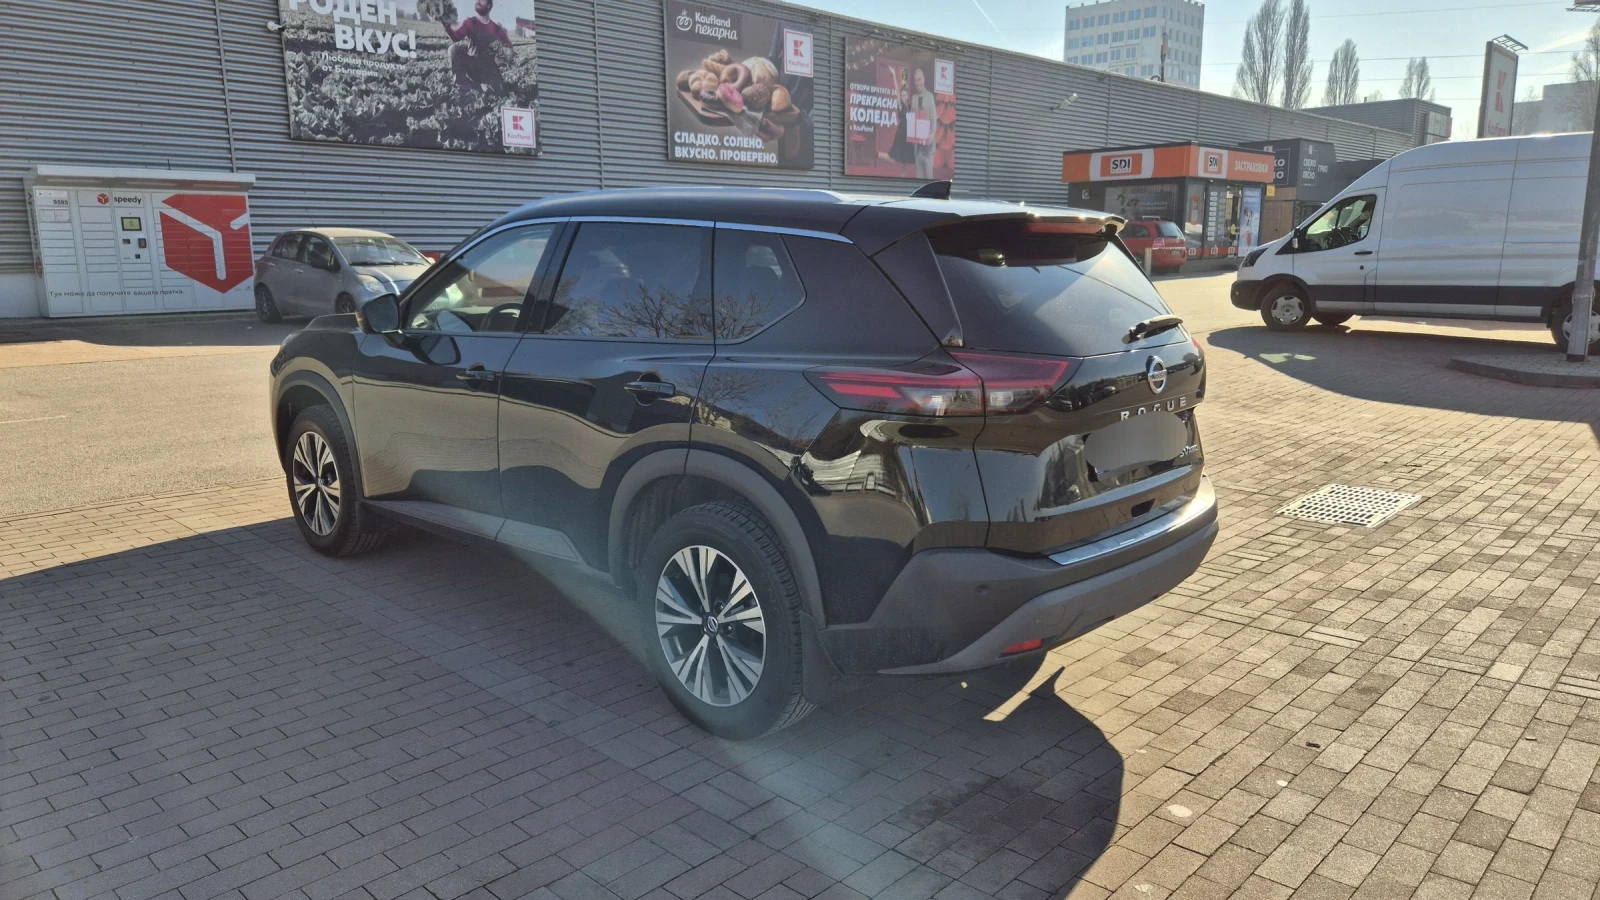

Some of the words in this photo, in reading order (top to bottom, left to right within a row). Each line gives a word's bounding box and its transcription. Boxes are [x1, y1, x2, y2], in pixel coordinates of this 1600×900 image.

[695, 12, 731, 28] Kaufland
[335, 23, 417, 59] ВКУС!
[322, 64, 333, 72] от
[849, 83, 870, 93] ОТВОРИ
[849, 93, 898, 109] ПРЕКРАСНА
[849, 107, 898, 127] КОЛЕДА
[507, 133, 531, 141] Kaufland
[674, 131, 721, 147] СЛАДКО.
[723, 135, 764, 149] СОЛЕНО.
[674, 146, 718, 160] ВКУСНО.
[720, 149, 779, 164] ПРОВЕРЕНО.
[1111, 158, 1131, 170] SDI
[113, 195, 142, 205] speedy
[1120, 397, 1187, 421] ROGUE
